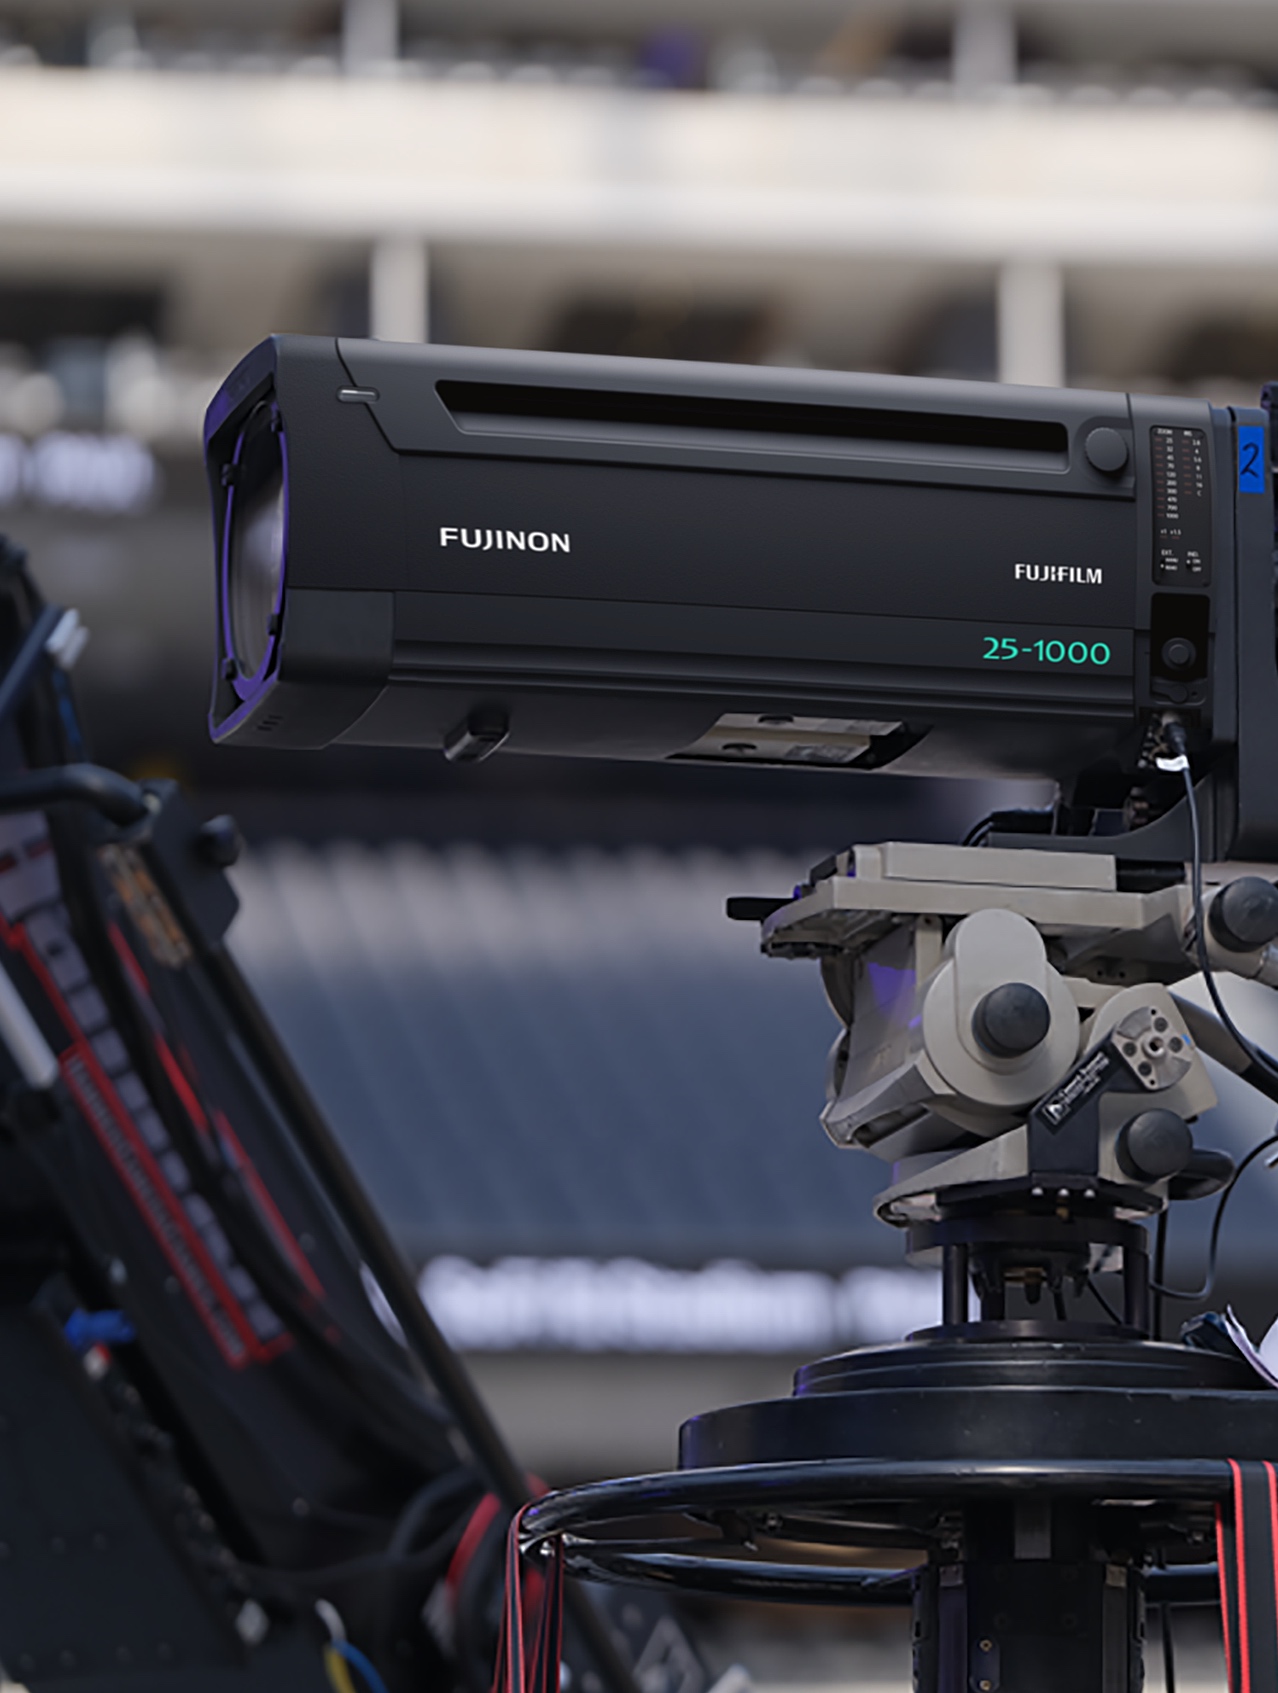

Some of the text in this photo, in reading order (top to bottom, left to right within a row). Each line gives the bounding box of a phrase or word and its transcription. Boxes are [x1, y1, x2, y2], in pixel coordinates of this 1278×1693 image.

[1240, 442, 1260, 478] 2
[439, 526, 571, 553] FUJINON
[1014, 562, 1103, 585] FUJIFILM
[982, 636, 1111, 666] 25-1000
